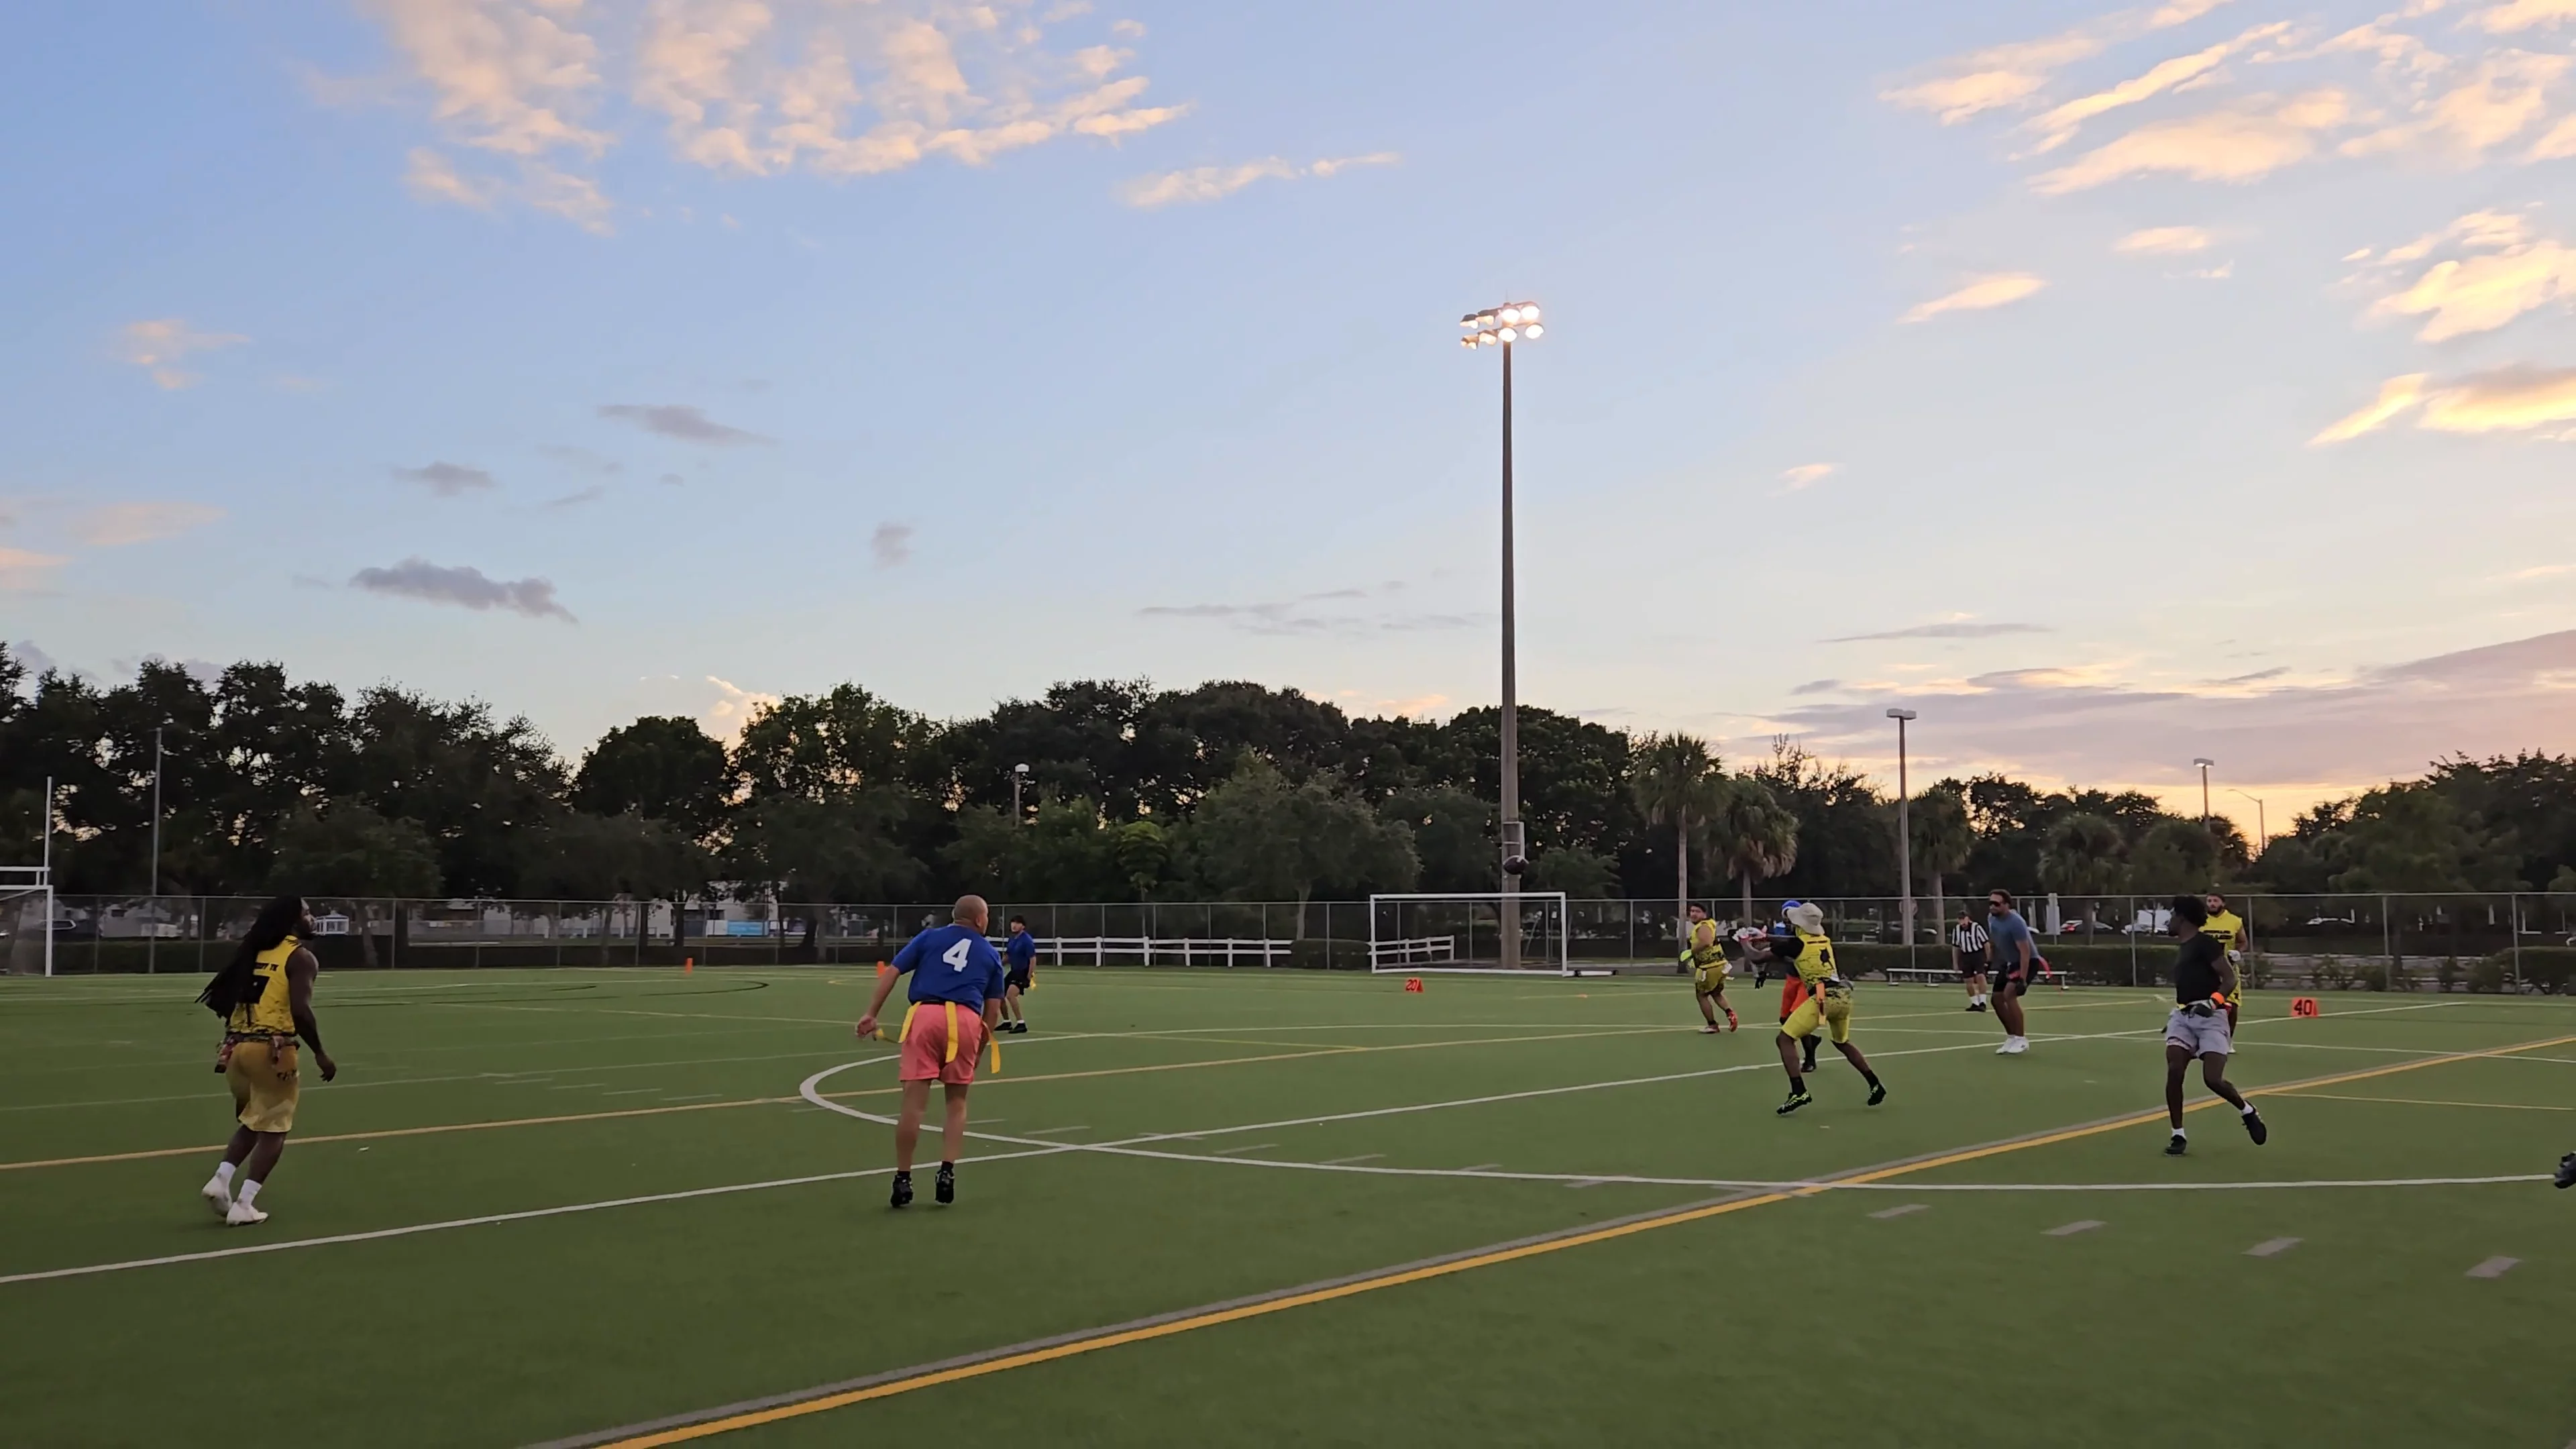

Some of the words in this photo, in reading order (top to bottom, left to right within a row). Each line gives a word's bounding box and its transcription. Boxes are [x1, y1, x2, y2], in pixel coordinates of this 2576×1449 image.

[943, 938, 973, 972] 4
[1406, 979, 1418, 991] 20
[2294, 999, 2313, 1016] 40
